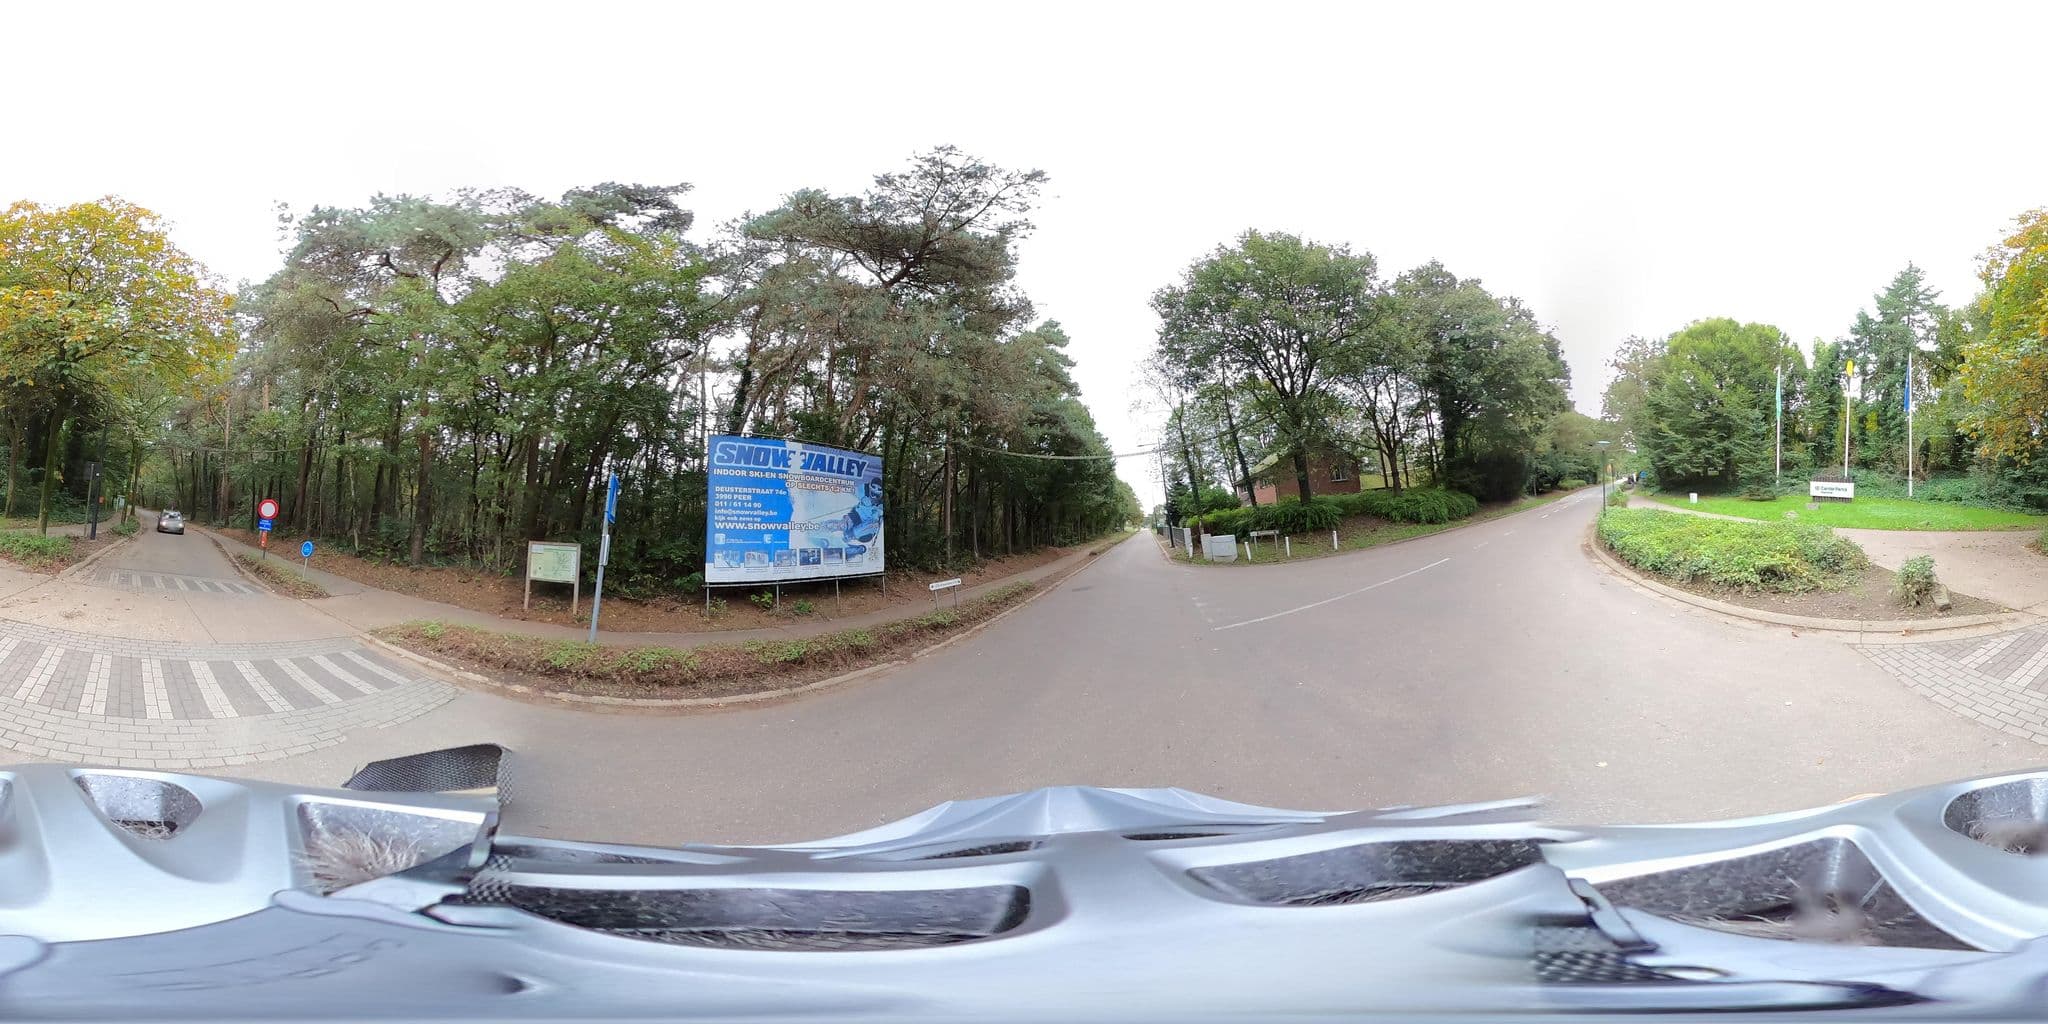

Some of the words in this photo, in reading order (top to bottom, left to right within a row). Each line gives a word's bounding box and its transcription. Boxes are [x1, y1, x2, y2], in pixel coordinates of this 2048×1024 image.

[715, 442, 796, 469] SNOW
[800, 451, 868, 478] VALLEY
[714, 468, 747, 477] INDOOR
[749, 470, 776, 479] SKI-EN
[778, 473, 855, 486] SNOWBOARDCENTRUM
[715, 486, 774, 495] DEUSTERSTRAAT
[798, 483, 829, 491] SLECHTS
[714, 521, 820, 532] www.snowvalley.be
